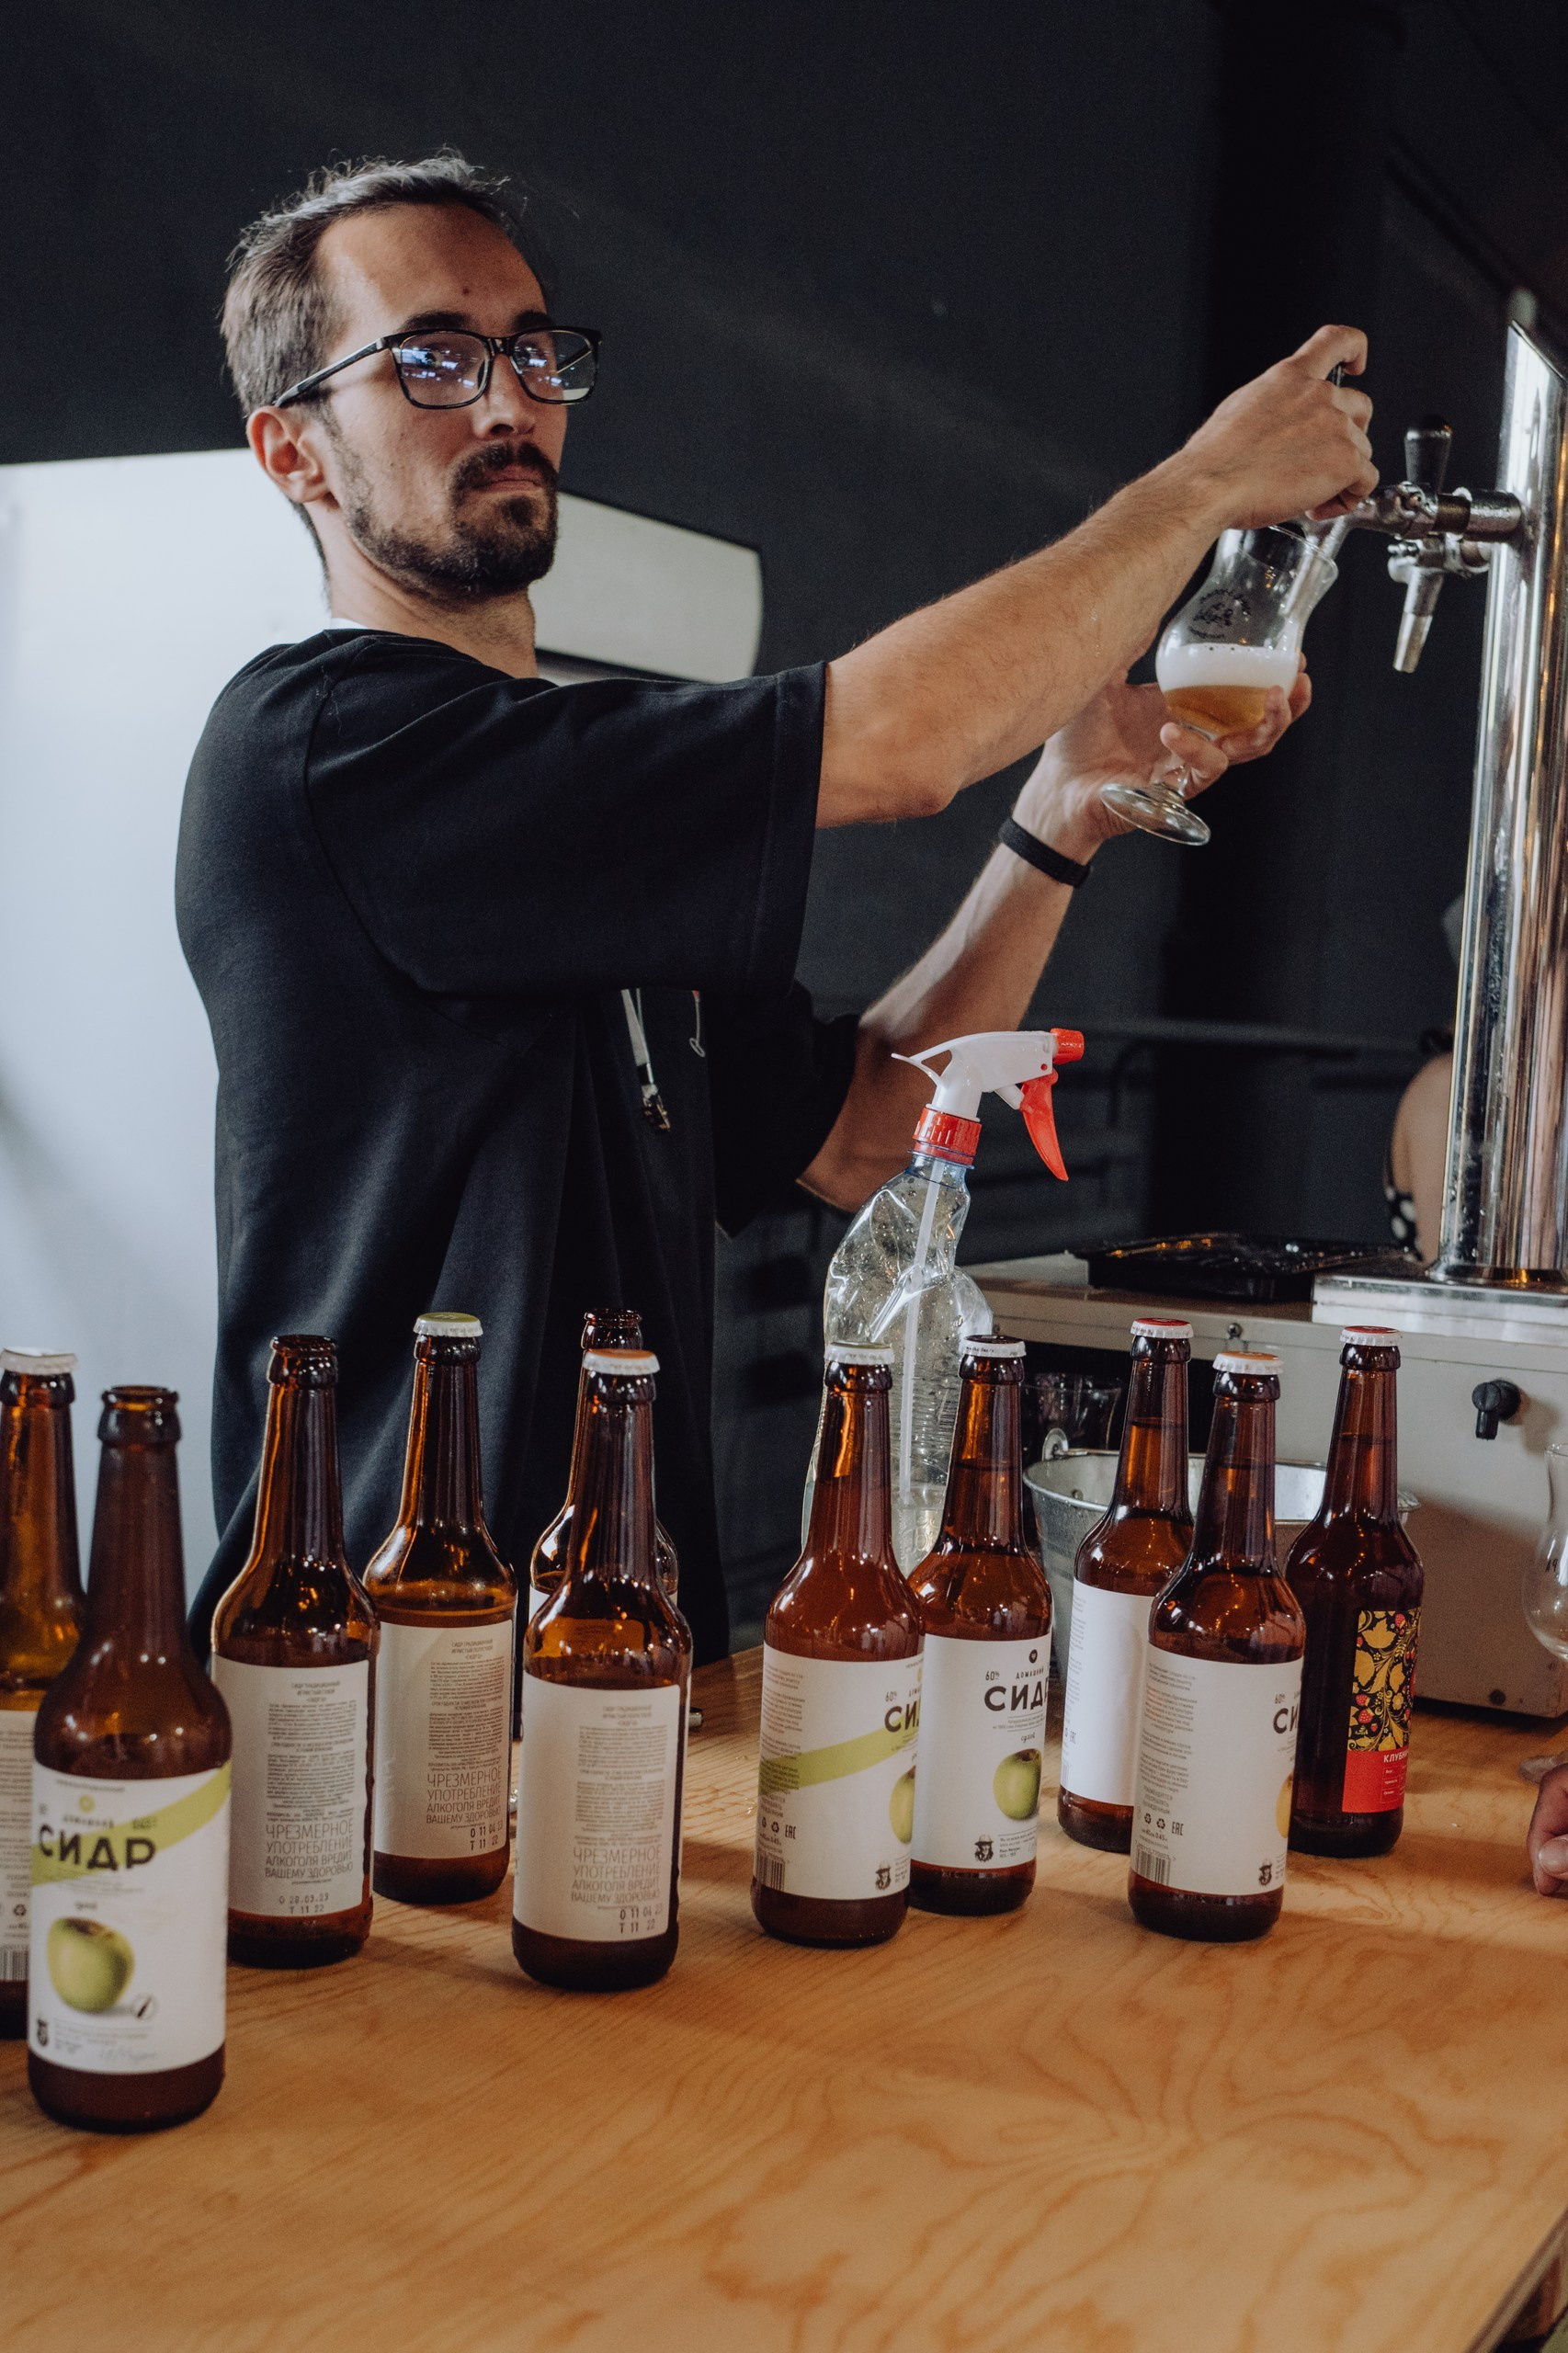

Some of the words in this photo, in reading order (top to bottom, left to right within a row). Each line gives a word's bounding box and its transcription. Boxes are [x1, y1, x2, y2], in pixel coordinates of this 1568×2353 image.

[884, 1701, 920, 1733] СИ
[426, 1766, 501, 1788] ЧРЕЗМЕРНОЕ
[426, 1780, 501, 1802] УПОТРЕБЛЕНИЕ
[426, 1801, 474, 1813] АЛКОГОЛЯ
[476, 1795, 500, 1810] ВРЕДИТ
[426, 1813, 463, 1824] ВАШЕМУ
[464, 1806, 501, 1823] ЗДОРОВЬЮ
[266, 1818, 354, 1839] ЧРЕЗМЕРНОЕ
[39, 1824, 156, 1871] СИДР
[266, 1835, 354, 1855] УПОТРЕБЛЕНИЕ
[573, 1845, 663, 1864] ЧРЕЗМЕРНОЕ
[266, 1856, 319, 1868] АЛКОГОЛЯ
[321, 1849, 352, 1866] ВРЕДИТ
[265, 1867, 306, 1879] ВАШЕМУ
[307, 1861, 354, 1878] ЗДОРОВЬЮ
[573, 1861, 662, 1880] УПОТРЕБЛЕНИЕ
[572, 1879, 626, 1892] АЛКОГОЛЯ
[628, 1876, 660, 1891] ВРЕДИТ
[571, 1892, 611, 1904] ВАШЕМУ
[613, 1888, 660, 1904] ЗДОРОВЬЮ
